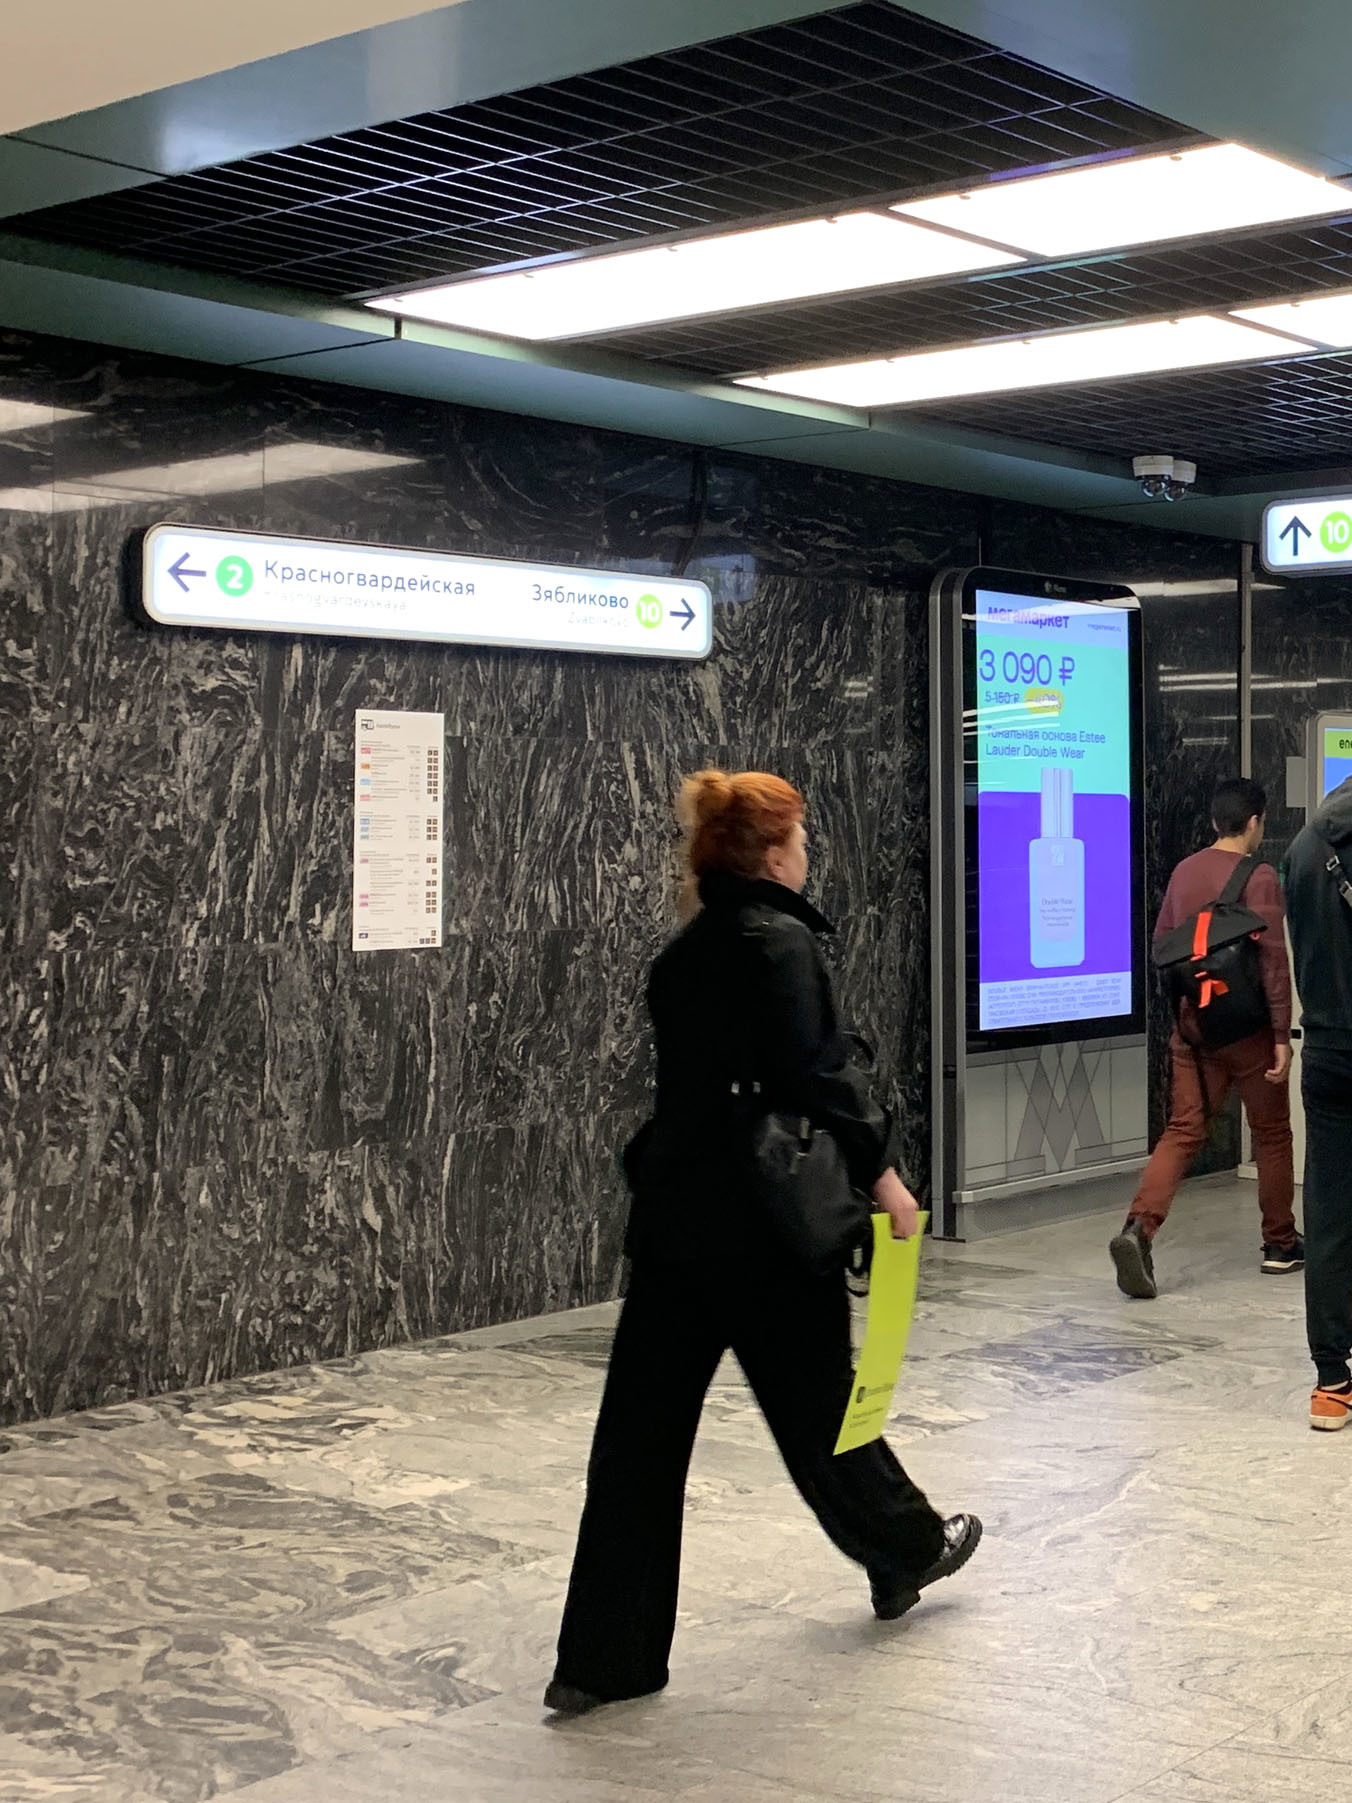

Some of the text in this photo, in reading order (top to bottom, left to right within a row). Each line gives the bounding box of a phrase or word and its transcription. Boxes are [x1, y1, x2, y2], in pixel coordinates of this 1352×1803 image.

[1326, 520, 1349, 544] 10
[226, 560, 475, 596] 2 Красногвардейская
[532, 584, 660, 622] Зябликово 10
[979, 649, 996, 682] 3
[1003, 651, 1052, 686] 090
[985, 743, 1086, 759] Lauder Double Wear
[1042, 731, 1077, 743] основа
[1079, 731, 1106, 744] Estee
